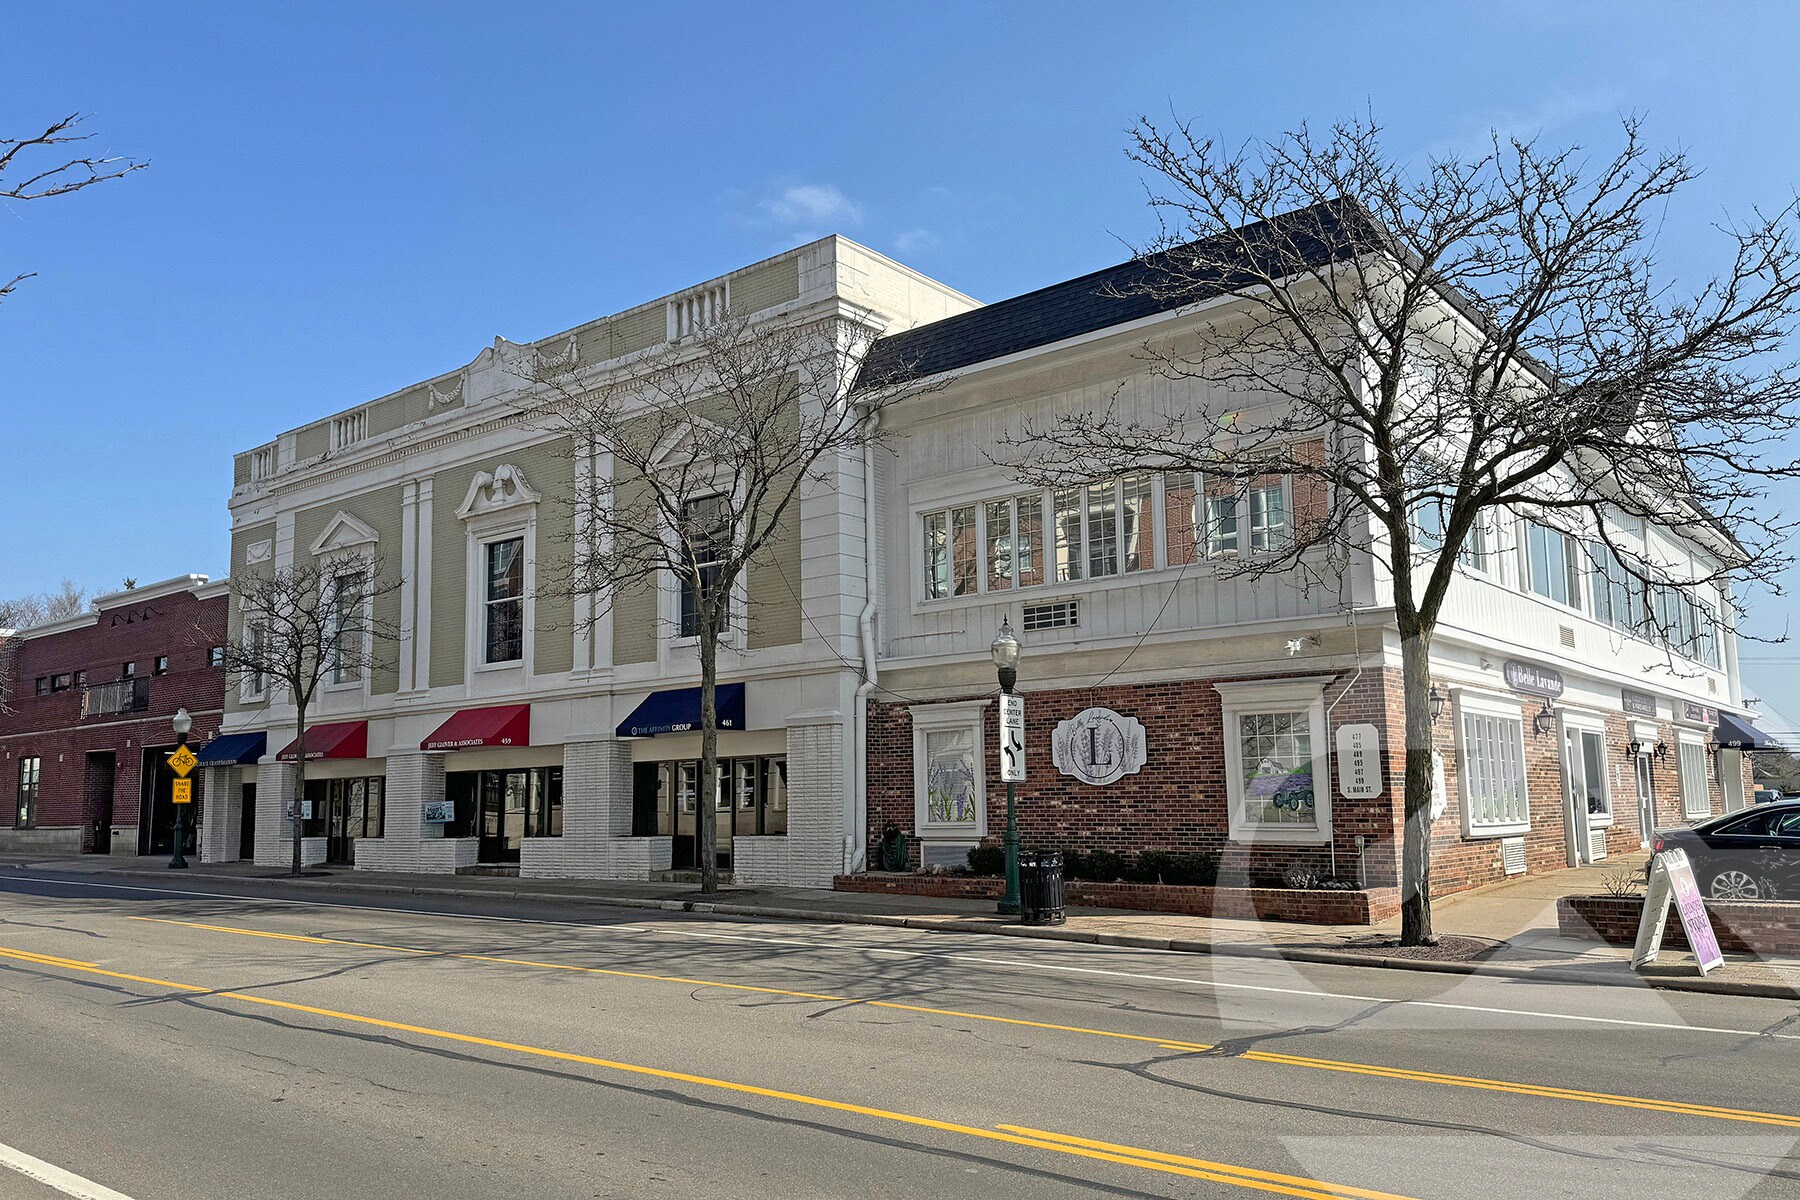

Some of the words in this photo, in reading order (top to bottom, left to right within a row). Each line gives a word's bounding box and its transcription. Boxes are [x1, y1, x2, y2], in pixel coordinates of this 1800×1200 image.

[1517, 665, 1535, 686] Belle
[648, 725, 671, 733] AFFINITY
[671, 723, 691, 731] GROUP
[1086, 727, 1112, 766] L
[1353, 750, 1363, 758] 489
[1354, 759, 1363, 767] 495
[1687, 915, 1707, 932] STORE
